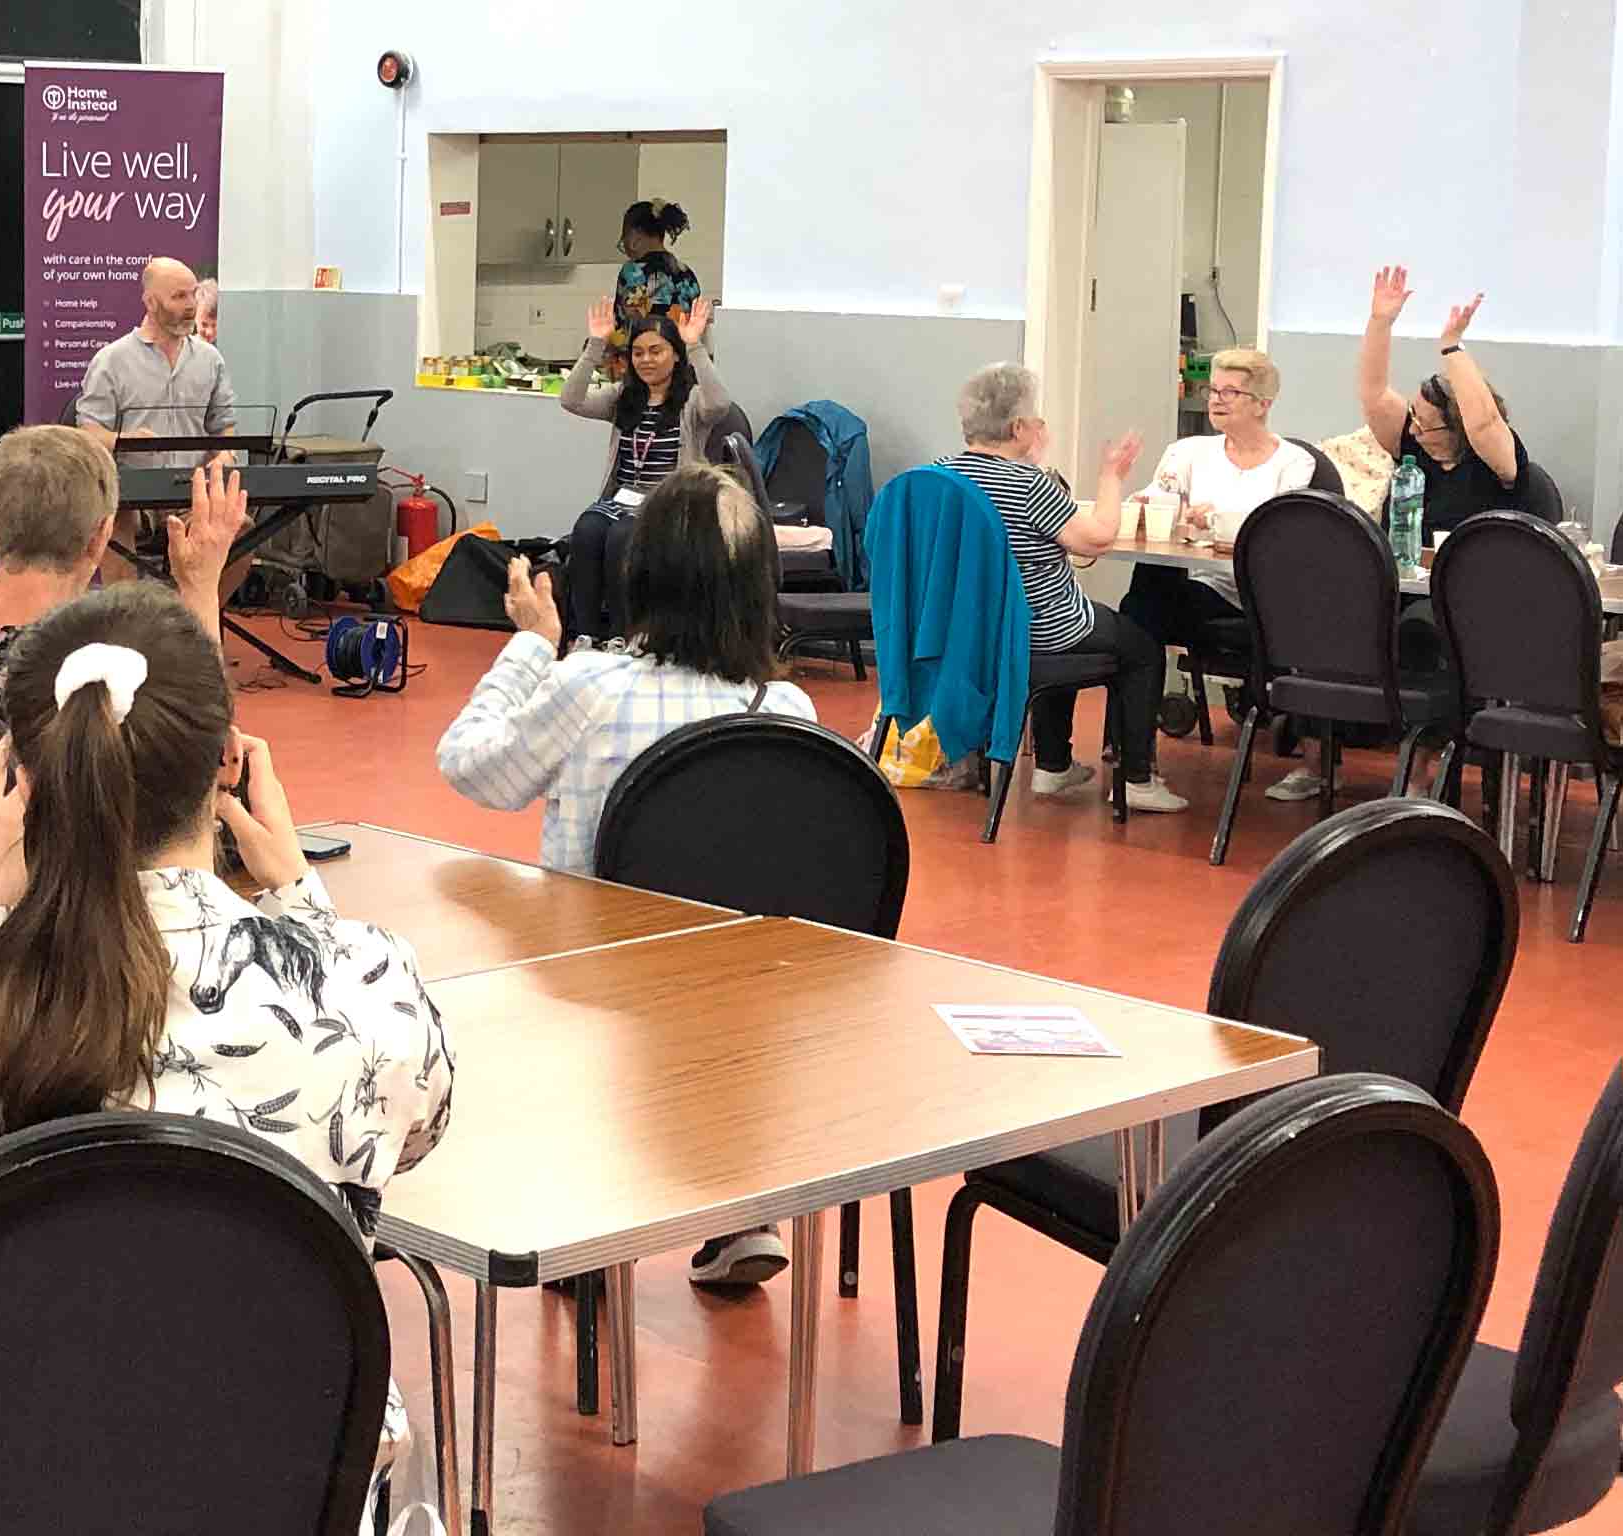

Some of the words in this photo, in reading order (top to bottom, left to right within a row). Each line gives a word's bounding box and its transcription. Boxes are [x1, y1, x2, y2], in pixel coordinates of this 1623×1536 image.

[67, 86, 108, 99] Home
[67, 99, 117, 111] Instead
[42, 141, 112, 178] Live
[122, 142, 198, 183] well,
[42, 188, 125, 242] your
[134, 191, 206, 230] way
[43, 254, 67, 265] with
[68, 256, 91, 265] care
[93, 254, 103, 265] in
[105, 254, 123, 265] the
[125, 254, 154, 265] comf
[43, 269, 56, 281] of
[57, 271, 80, 284] your
[83, 271, 106, 281] own
[108, 269, 139, 281] home
[55, 299, 78, 308] Home
[79, 299, 98, 309] Help
[55, 320, 117, 329] Companionship
[55, 339, 89, 349] Personal
[55, 359, 89, 369] Dementi
[306, 476, 345, 484] RECITAL
[346, 475, 367, 483] PRO
